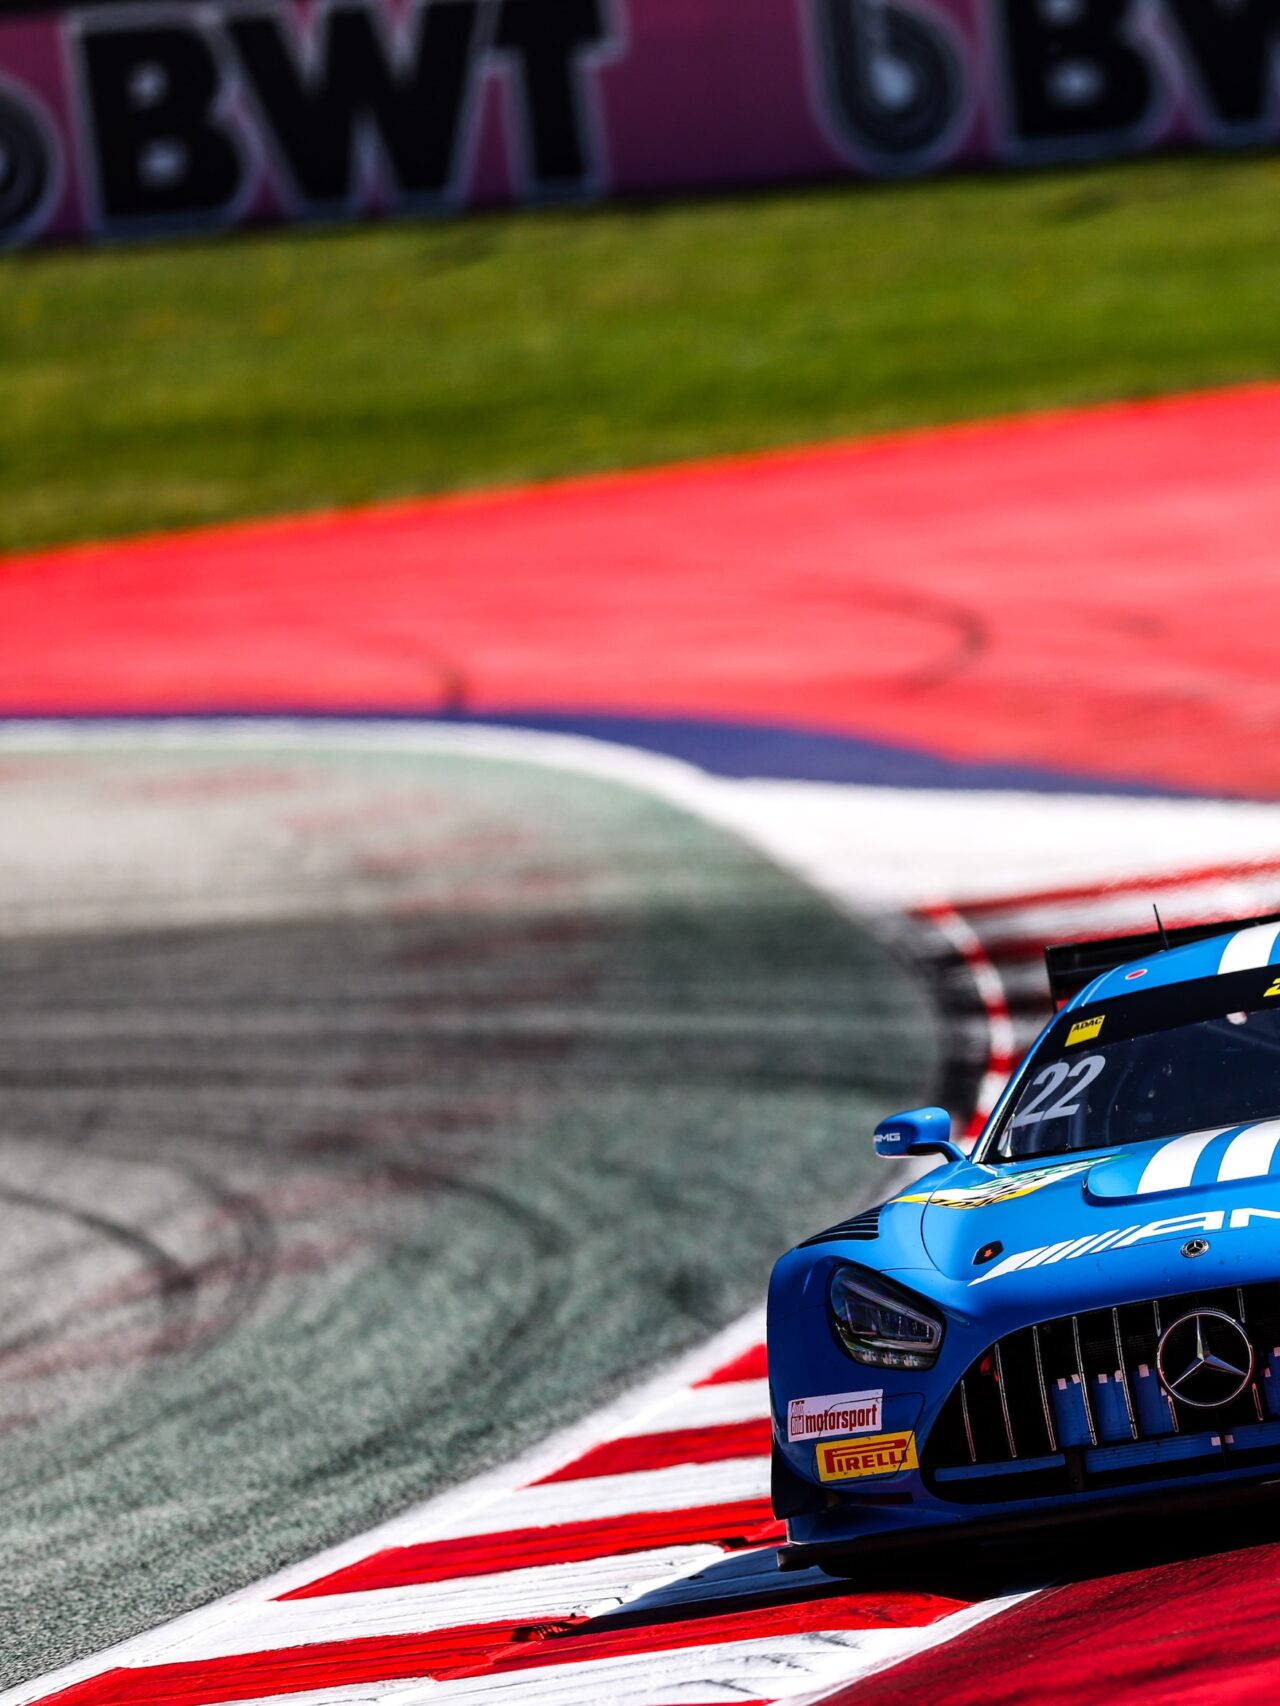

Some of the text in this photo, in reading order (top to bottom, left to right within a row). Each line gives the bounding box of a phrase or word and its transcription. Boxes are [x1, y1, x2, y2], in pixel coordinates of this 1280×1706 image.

[72, 0, 620, 226] BWT
[1072, 1016, 1103, 1033] ADAC
[1010, 1054, 1106, 1128] 22
[873, 1132, 901, 1144] AMG
[805, 1404, 878, 1434] motorsport
[823, 1438, 909, 1474] PIRELLI
